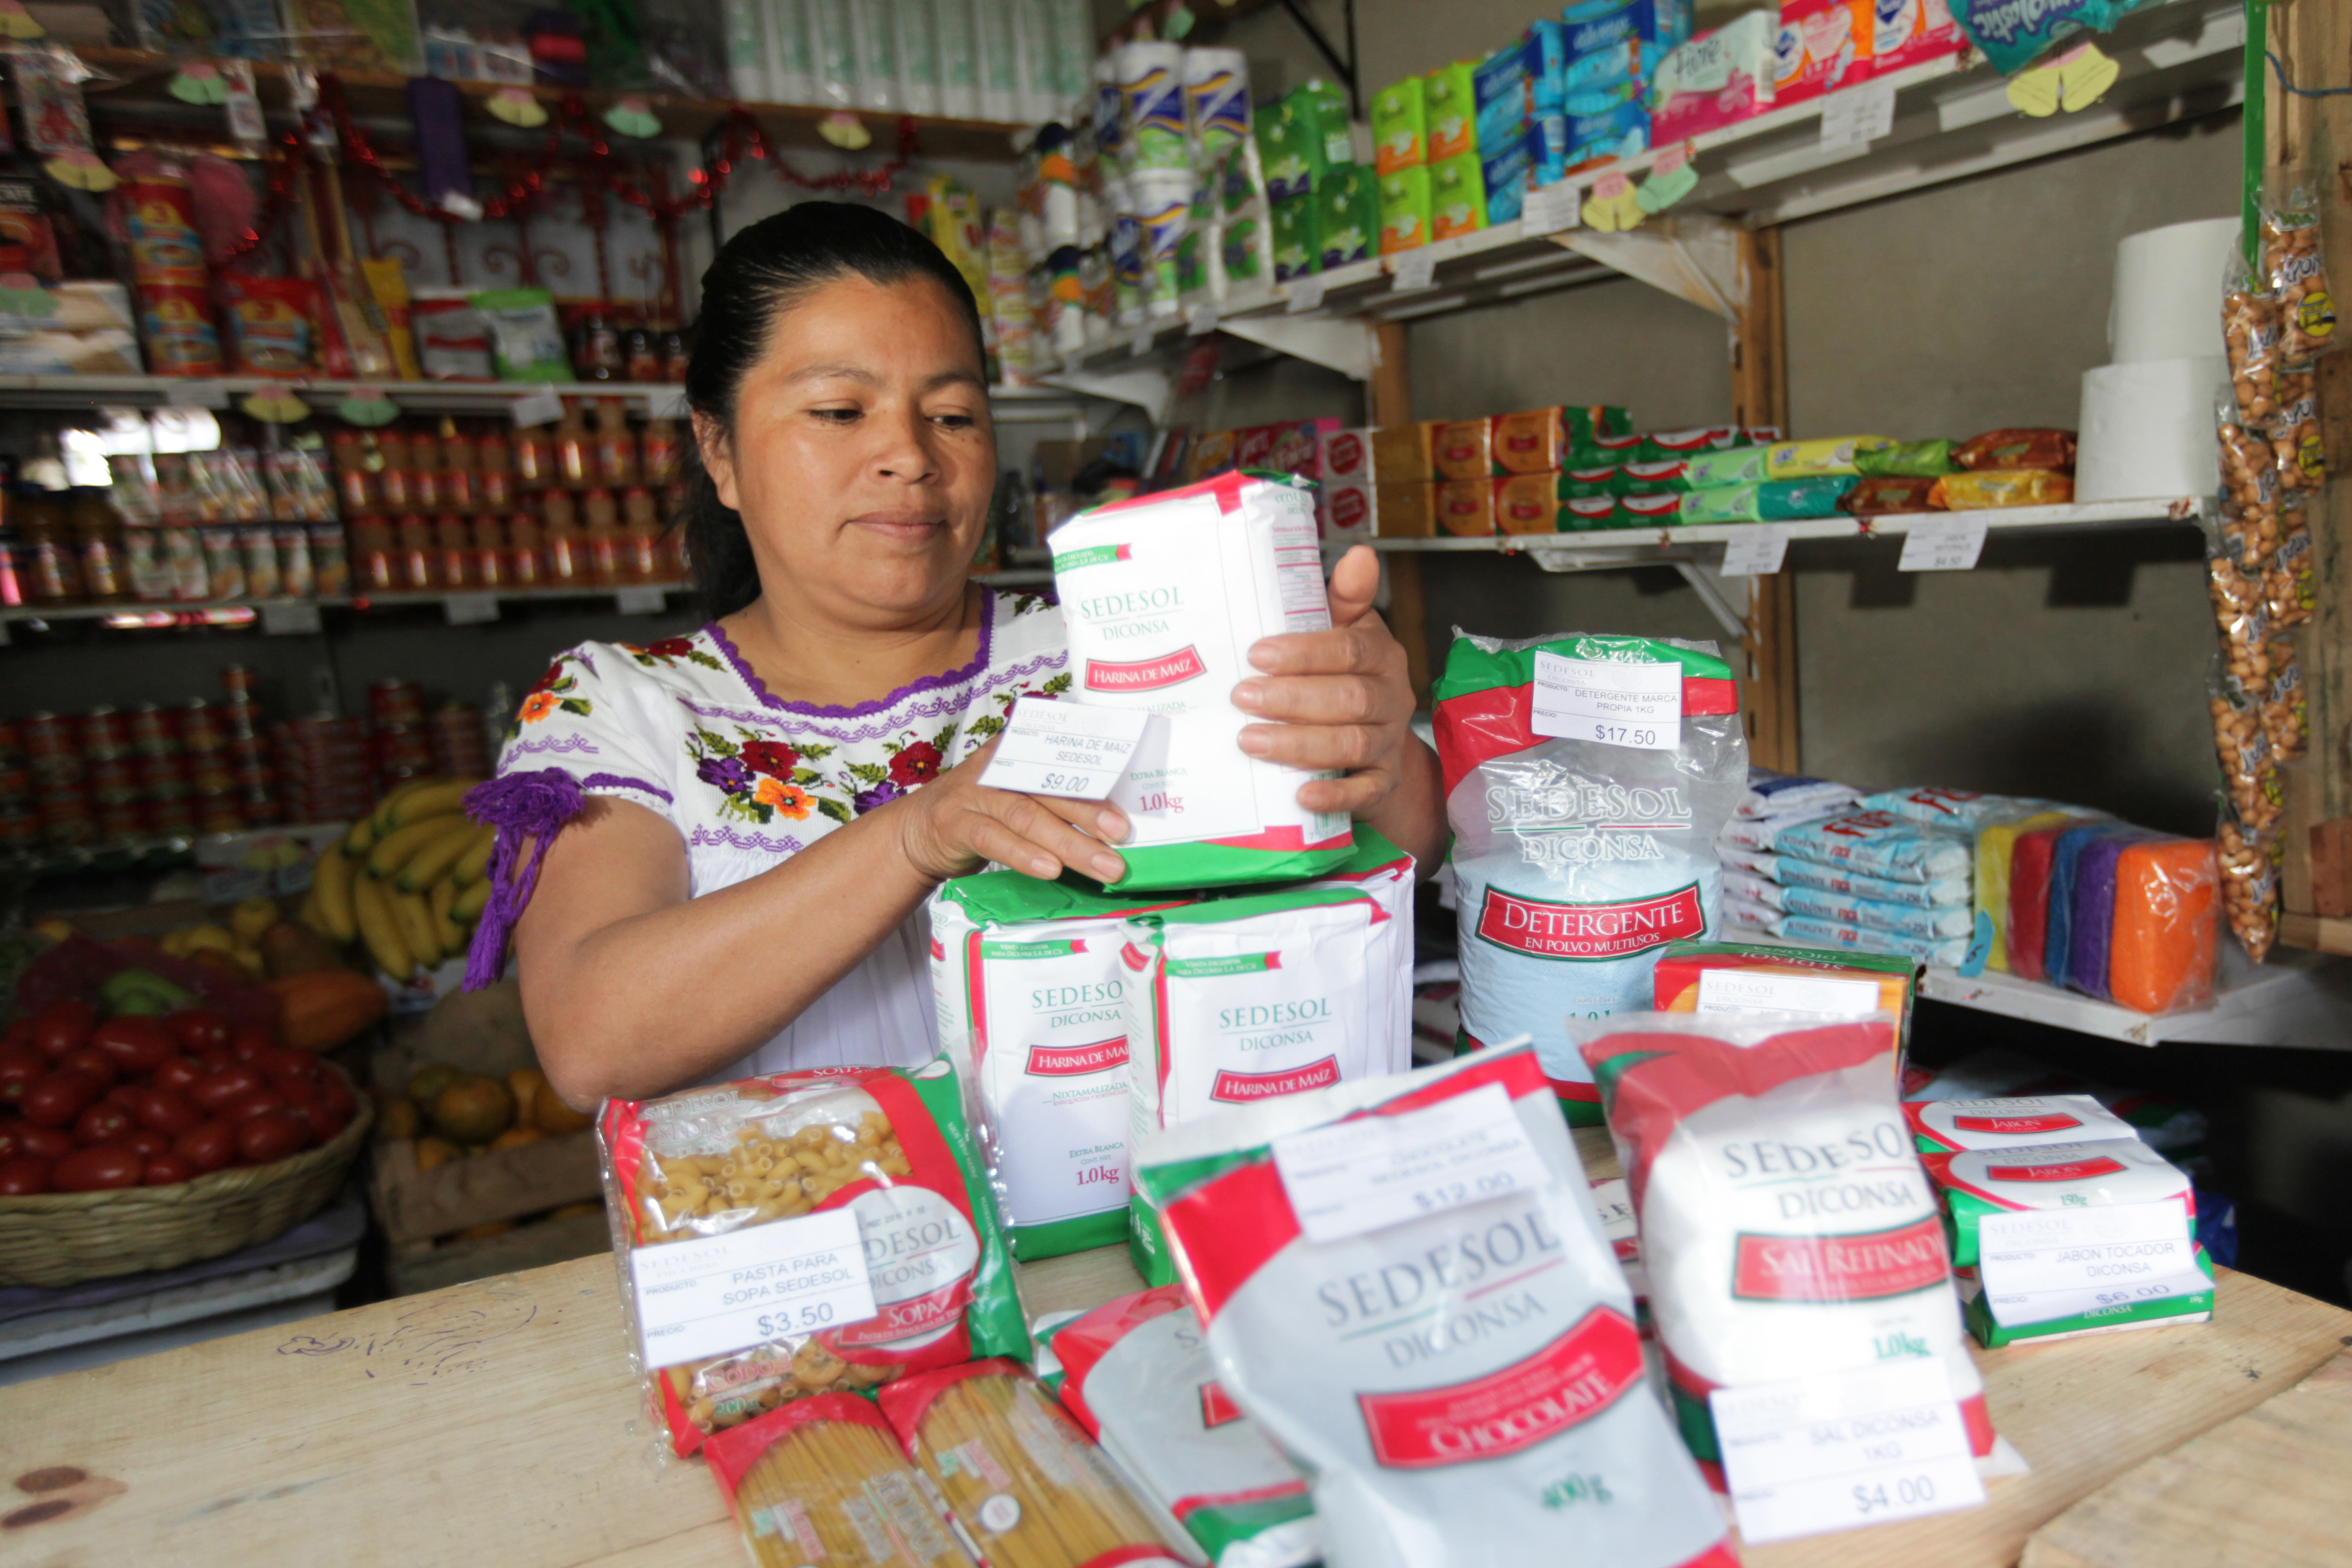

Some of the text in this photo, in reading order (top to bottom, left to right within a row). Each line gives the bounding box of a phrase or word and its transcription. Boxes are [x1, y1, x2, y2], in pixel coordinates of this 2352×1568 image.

[1081, 586, 1185, 619] SEDESOL
[1103, 620, 1171, 641] DICONSA
[1094, 659, 1194, 683] HARINA DE MAÍZ
[1540, 660, 1596, 678] SEDESOL
[1537, 681, 1569, 691] PRODUCTO:
[1548, 675, 1586, 686] DICONSA
[1575, 689, 1639, 702] DETERGENTE
[1016, 709, 1068, 722] SEDESOL
[1533, 709, 1558, 718] PRECIO:
[1597, 702, 1632, 713] PROPIA
[1044, 734, 1132, 754] HARINA DE MAIZ
[1595, 724, 1656, 745] $17.50
[1056, 751, 1102, 766] SEDESOL
[1041, 773, 1090, 792] $9.00
[1130, 767, 1188, 781] EXTRA BLANCA
[1486, 784, 1692, 823] SEDESOL
[1521, 833, 1664, 864] DICONSA
[1504, 901, 1684, 936] DETERGENTE
[1525, 932, 1660, 953] EN POLVO MULTIUSOS
[1739, 951, 1844, 970] SEDESOL
[1754, 946, 1837, 960] DICONSA
[1032, 980, 1123, 1009] SEDESO
[1706, 981, 1777, 995] SEDESOL
[1717, 995, 1764, 1005] DICONSA
[1051, 1009, 1122, 1029] DICONSA
[1220, 997, 1333, 1029] SEDESOL
[1240, 1029, 1314, 1052] DICONSA
[1039, 1041, 1129, 1068] HARINA DE MAÍ
[1052, 1081, 1128, 1101] NIXTAMALIZADA
[1225, 1068, 1332, 1095] HARINA DE MAÍZ
[645, 1091, 745, 1121] SEDESOL
[1053, 1096, 1091, 1106] ENRIQUECIDA
[1096, 1089, 1129, 1099] FORTIFICADA
[1969, 1107, 2043, 1116] DICONSA
[1069, 1142, 1124, 1158] EXTRA BLANCA
[1723, 1122, 1915, 1178] SEDESO
[2004, 1152, 2083, 1165] DICONSA
[1777, 1181, 1917, 1219] DICONSA
[1989, 1219, 2071, 1236] SEDESOL
[863, 1218, 961, 1262] DESOL
[1760, 1245, 1813, 1277] SAL
[2055, 1243, 2175, 1263] JABON TOCADOR
[732, 1252, 839, 1285] PASTA PARA
[1317, 1210, 1563, 1328] SEDESOL
[2086, 1262, 2152, 1277] DICONSA
[646, 1280, 699, 1296] PRODUCTO:
[723, 1267, 855, 1306] SOPA SEDESOL
[2096, 1284, 2170, 1304] $6.00
[757, 1302, 834, 1336] $3.50
[888, 1299, 942, 1328] SOPA
[2084, 1304, 2133, 1319] DICONSA
[647, 1324, 688, 1339] PRECIO:
[1383, 1290, 1549, 1369] DICONSA
[1429, 1369, 1612, 1457] CHOCOLATE
[1852, 1474, 1935, 1514] $4.00
